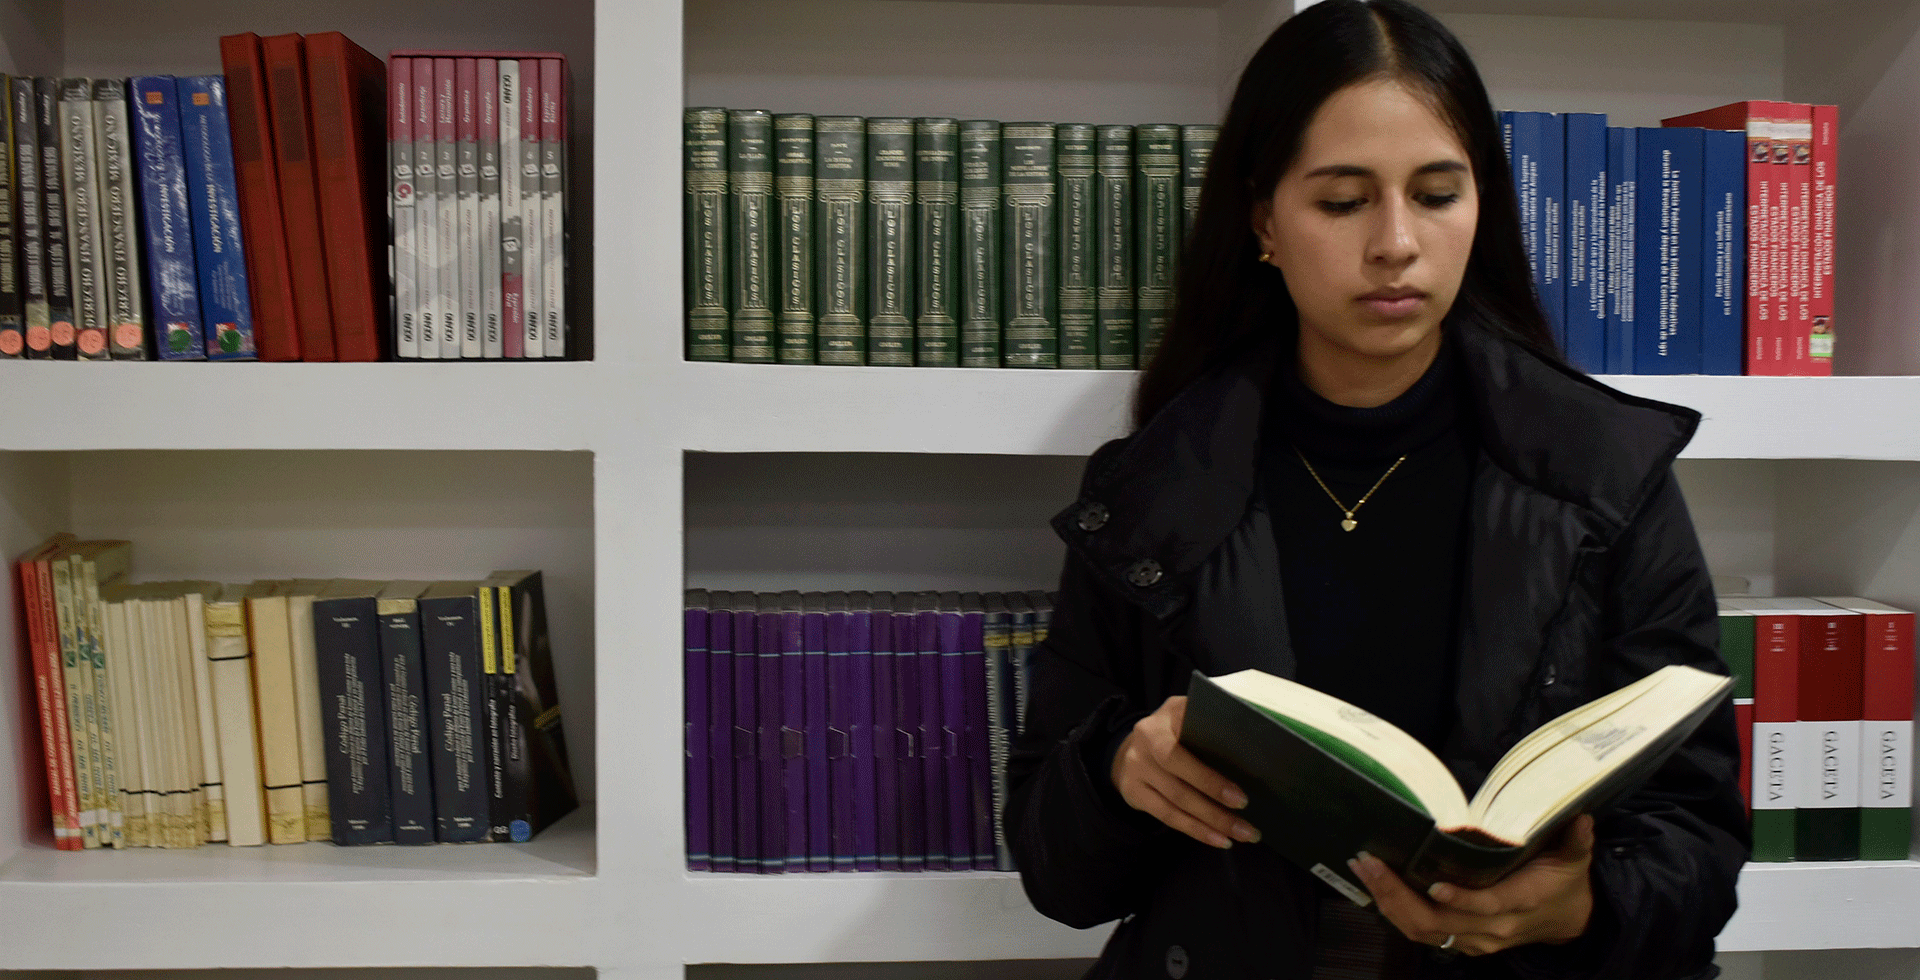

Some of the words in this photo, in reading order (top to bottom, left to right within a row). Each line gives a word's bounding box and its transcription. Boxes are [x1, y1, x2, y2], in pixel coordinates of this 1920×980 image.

[502, 75, 512, 104] OCEANO
[71, 115, 85, 182] MEXICANO
[105, 115, 119, 180] MEXICANO
[1662, 150, 1671, 178] durante
[1815, 180, 1824, 191] DE
[1816, 162, 1825, 177] LOS
[1661, 188, 1670, 227] Revolución
[1671, 180, 1680, 206] Justicia
[76, 187, 91, 263] FINANCIERO
[109, 186, 125, 261] FINANCIERO
[158, 184, 175, 253] INVESTIGACIÓN
[206, 184, 221, 253] INVESTIGACIÓN
[1671, 208, 1680, 234] Federal
[1750, 205, 1759, 241] ESTADOS
[1760, 181, 1769, 247] INTERPRETACIÓN
[1770, 206, 1779, 242] ESTADOS
[1779, 183, 1788, 249] INTERPRETACIÓN
[1791, 206, 1800, 242] ESTADOS
[1800, 183, 1809, 249] INTERPRETACIÓN
[1814, 194, 1824, 230] DINÁMICA
[1824, 185, 1834, 237] FINANCIEROS
[1660, 235, 1670, 264] después
[1671, 236, 1679, 244] en
[1671, 246, 1679, 256] las
[1661, 266, 1669, 274] de
[1750, 244, 1758, 296] FINANCIEROS
[1759, 250, 1768, 288] DINÁMICA
[1770, 245, 1778, 297] FINANCIEROS
[1779, 252, 1788, 288] DINÁMICA
[1790, 245, 1799, 297] FINANCIEROS
[1800, 252, 1809, 288] DINÁMICA
[1813, 232, 1822, 298] INTERPRETACIÓN
[1823, 240, 1832, 275] ESTADOS
[1670, 258, 1679, 293] Entidades
[81, 268, 96, 328] DERECHO
[1659, 285, 1669, 329] Constitución
[1759, 291, 1768, 301] DE
[1759, 304, 1768, 320] LOS
[1779, 291, 1788, 302] DE
[1799, 305, 1808, 320] LOS
[1800, 291, 1808, 302] DE
[404, 314, 413, 342] OCEANO
[424, 313, 433, 341] OCEANO
[445, 313, 454, 341] OCEANO
[466, 312, 476, 341] OCEANO
[488, 314, 497, 342] OCEANO
[528, 312, 538, 340] OCEANO
[548, 312, 557, 340] OCEANO
[1669, 295, 1678, 335] Federativas
[1778, 305, 1788, 321] LOS
[1658, 341, 1667, 356] 1917
[1660, 331, 1668, 340] de
[336, 695, 346, 719] Penal
[408, 695, 419, 728] Código
[441, 693, 452, 718] Penal
[488, 699, 498, 729] fotografía
[338, 720, 349, 754] Código
[411, 729, 422, 754] Penal
[444, 719, 455, 752] Código
[492, 729, 498, 737] en
[491, 738, 500, 765] narración
[1769, 732, 1785, 800] GACETA
[1824, 731, 1840, 800] GACETA
[1881, 731, 1897, 800] GACETA
[494, 771, 503, 798] Contexto
